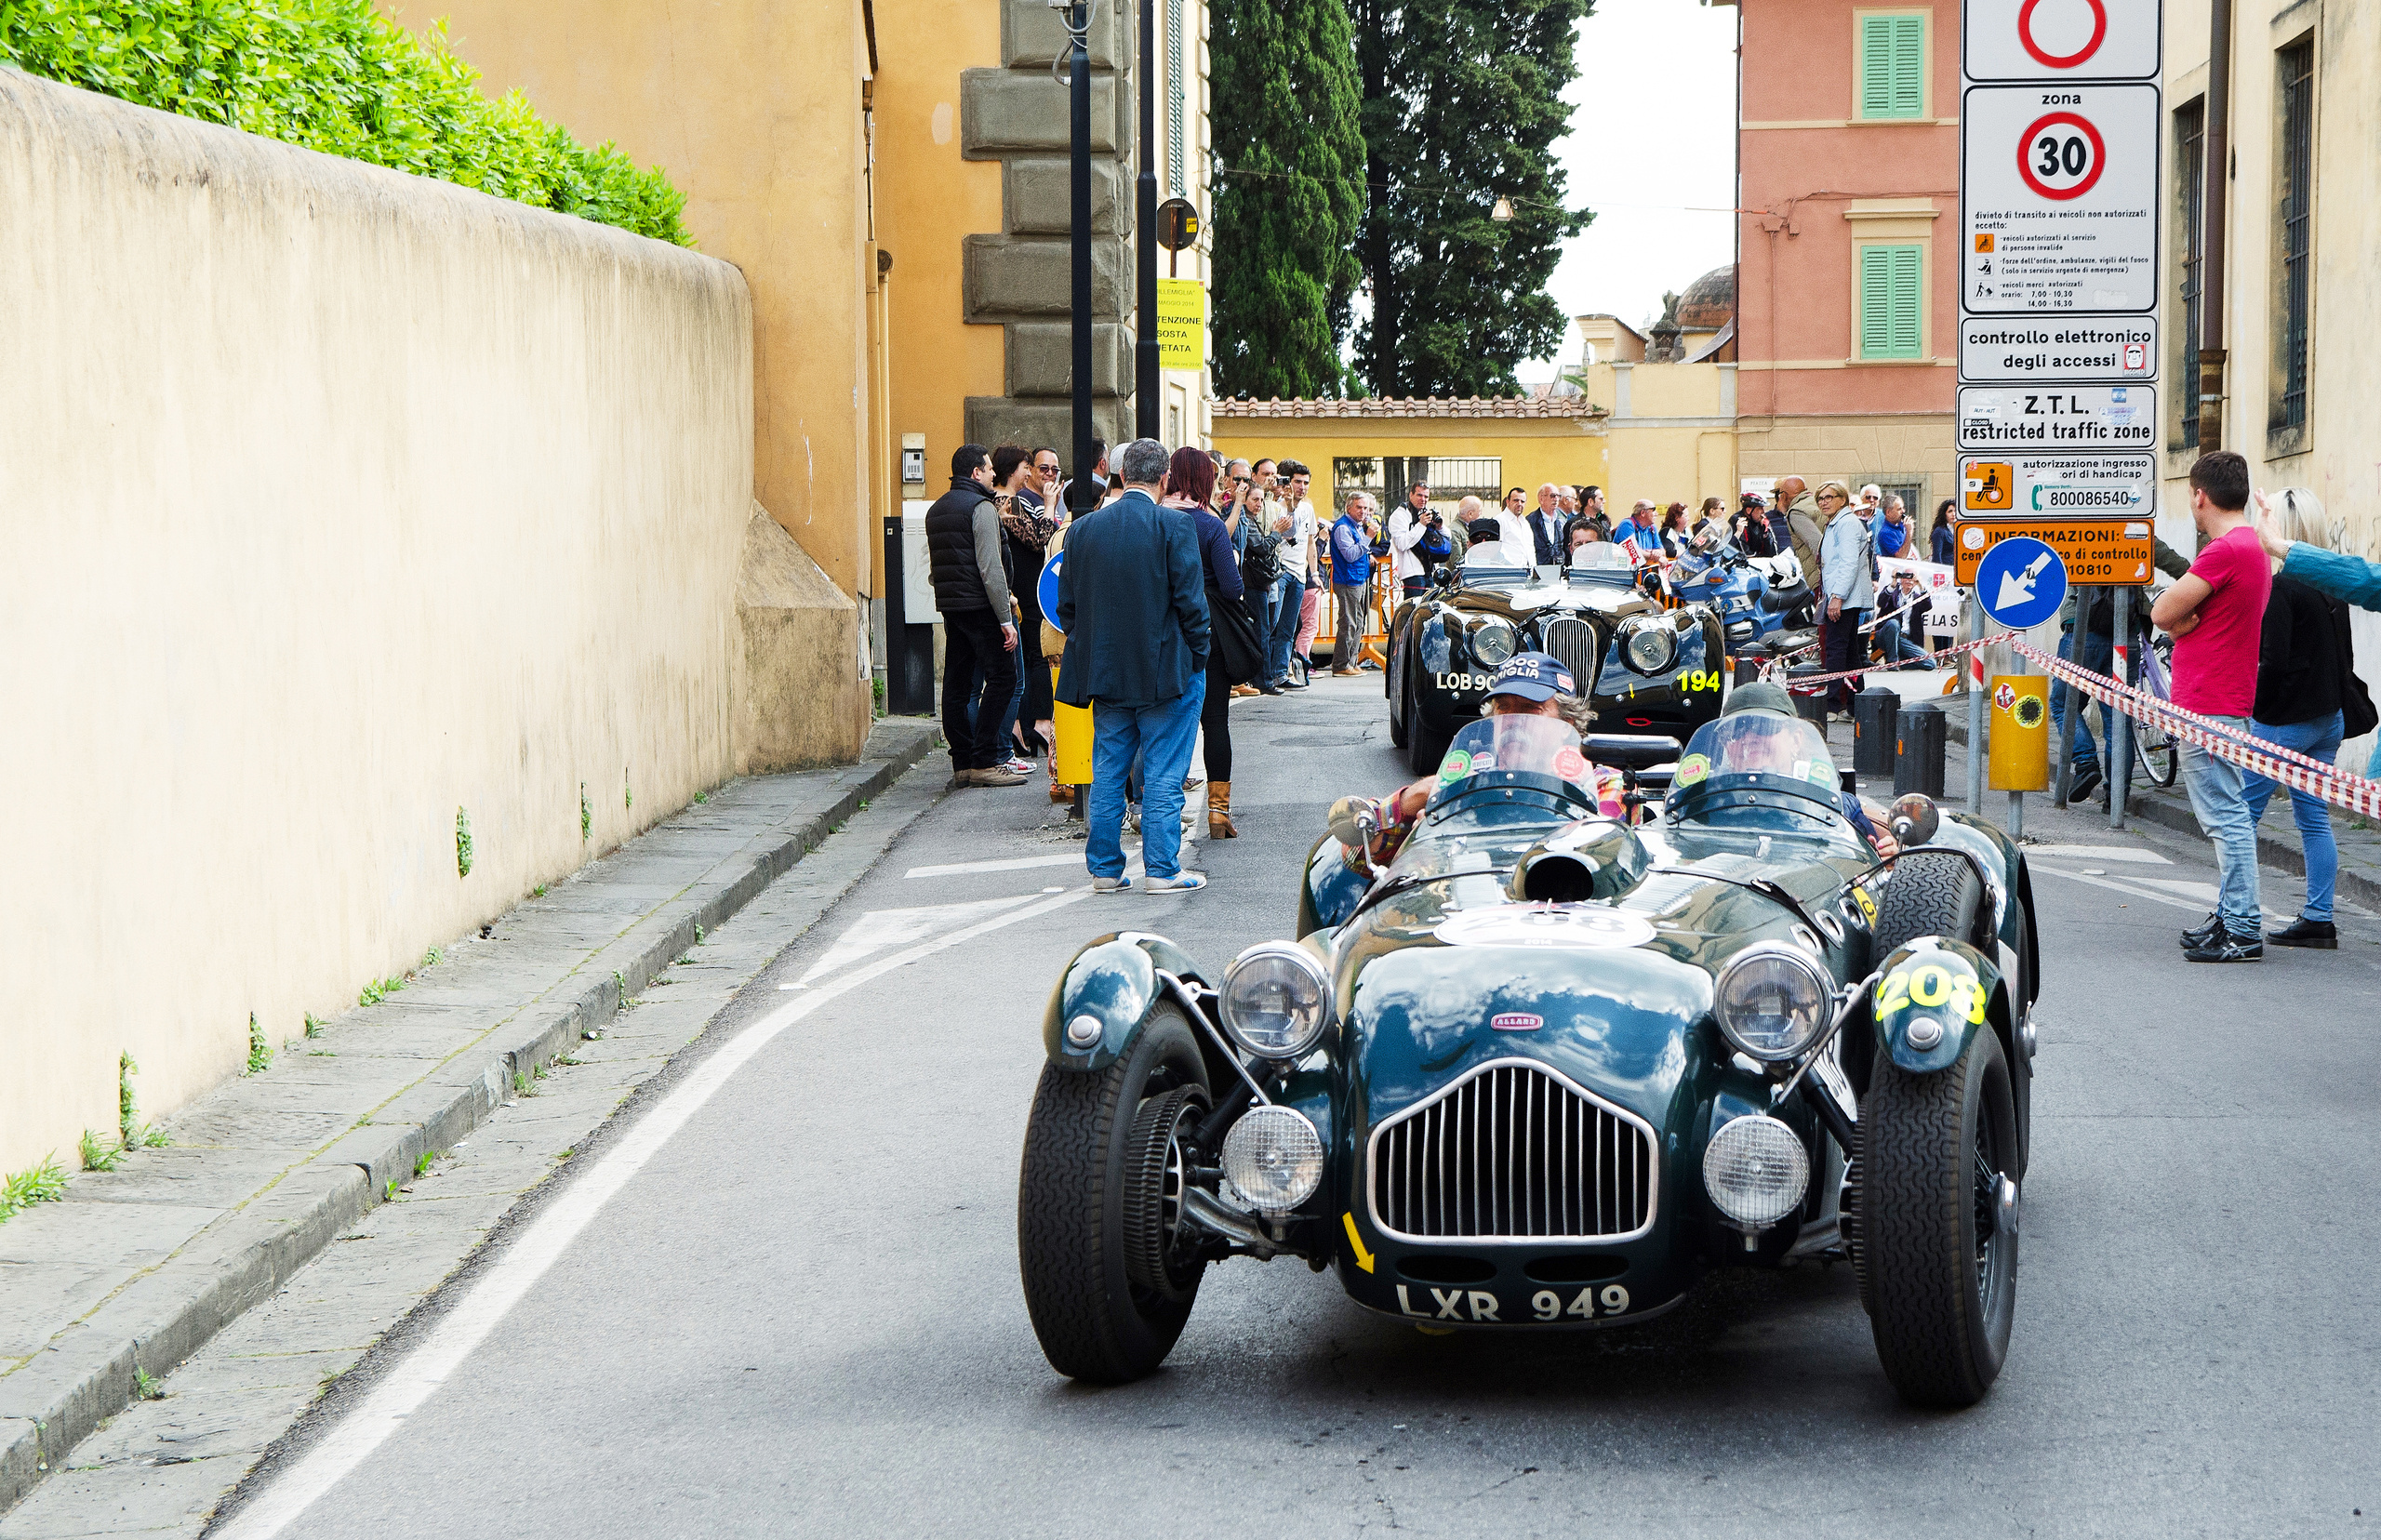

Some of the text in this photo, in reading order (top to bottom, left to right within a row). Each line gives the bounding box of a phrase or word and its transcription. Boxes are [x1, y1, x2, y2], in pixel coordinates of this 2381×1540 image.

[2042, 94, 2082, 105] zona
[2037, 136, 2087, 177] 30
[1975, 211, 2002, 219] divieto
[2004, 210, 2012, 219] di
[2015, 210, 2046, 219] transito
[2048, 210, 2056, 219] ai
[2058, 209, 2085, 219] veicoli
[2104, 209, 2147, 218] autorizzati
[1975, 221, 2007, 230] eccetto:
[1157, 316, 1202, 325] TENZIONE
[1969, 329, 2151, 344] controllo elettronico
[2003, 353, 2116, 370] degli accessi
[1962, 422, 2150, 440] restricted traffic zone
[2022, 459, 2148, 469] autorizzazione ingresso
[2079, 470, 2089, 479] di
[2093, 469, 2142, 479] handicap
[2050, 491, 2129, 506] 800086540
[2075, 548, 2086, 560] di
[2092, 547, 2148, 560] controllo
[1436, 671, 1472, 691] LOB
[1676, 670, 1721, 693] 194
[1875, 964, 1987, 1026] 208
[1496, 1017, 1536, 1026] ALLARD
[1396, 1284, 1629, 1321] LXR 949
